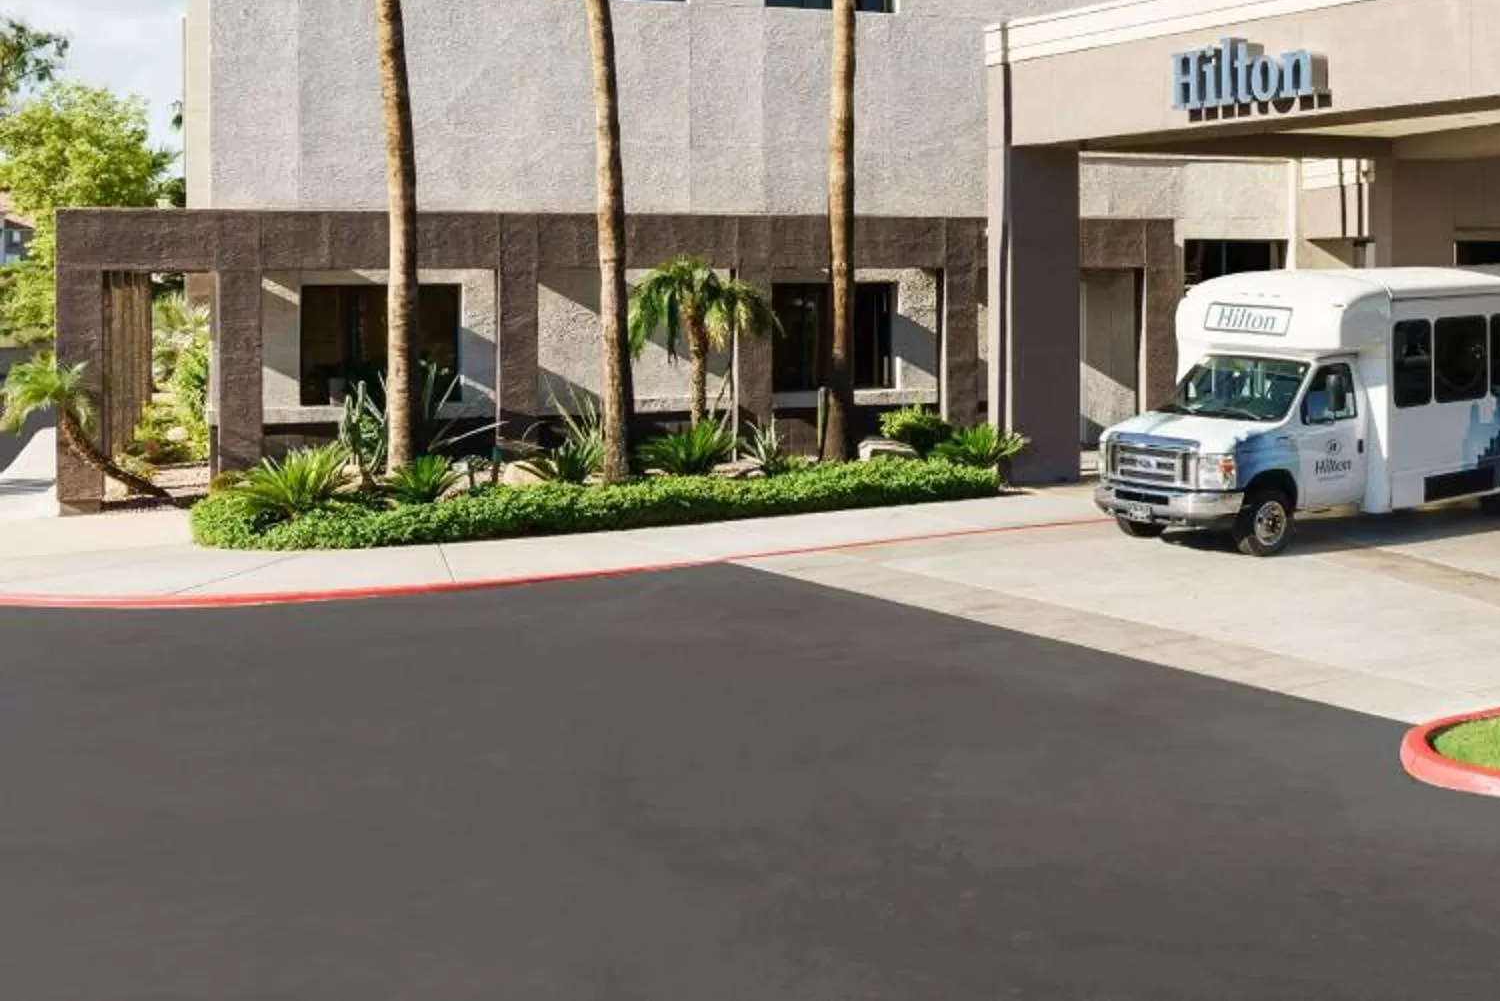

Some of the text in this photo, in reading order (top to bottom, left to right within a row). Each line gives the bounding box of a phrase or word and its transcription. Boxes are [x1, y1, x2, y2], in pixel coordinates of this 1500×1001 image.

[1171, 36, 1315, 109] Hilton
[1217, 306, 1276, 330] Hilton
[1314, 458, 1352, 475] Hilton
